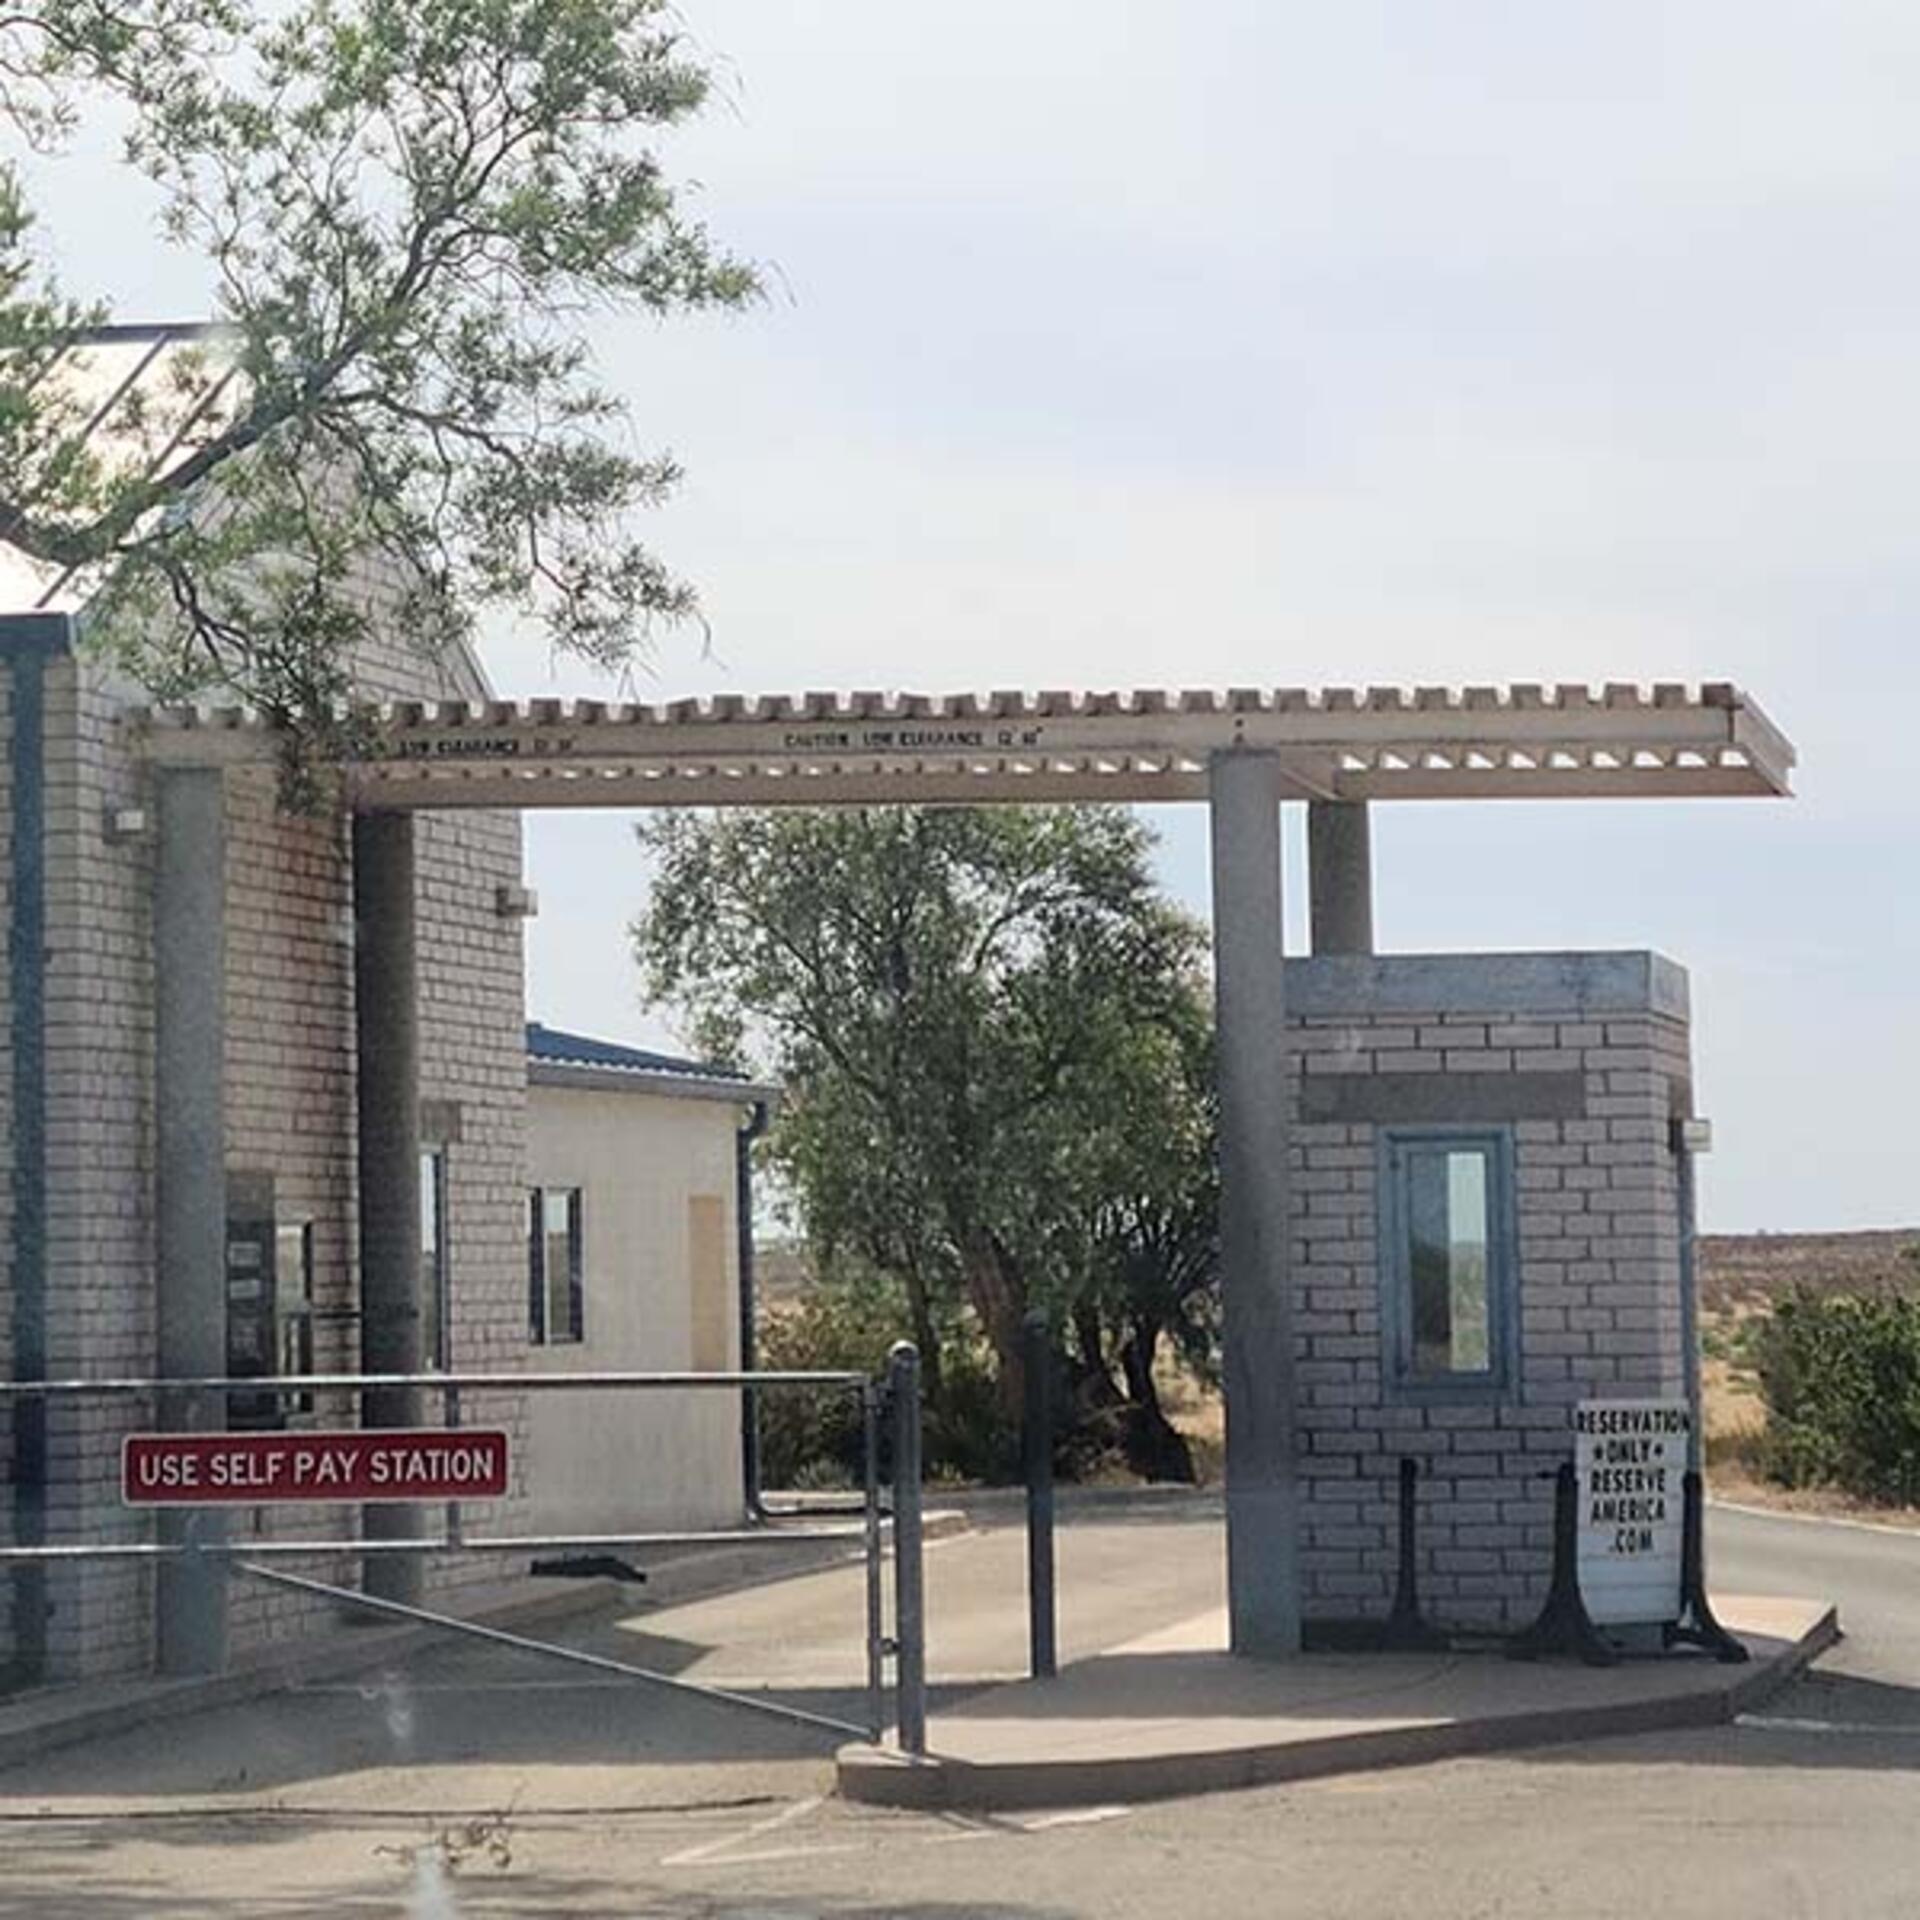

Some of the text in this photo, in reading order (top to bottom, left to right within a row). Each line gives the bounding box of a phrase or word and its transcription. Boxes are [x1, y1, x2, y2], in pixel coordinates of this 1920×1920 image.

[784, 733, 849, 748] CAUTION
[863, 732, 893, 747] LOW
[900, 731, 983, 747] CLEARANCE
[1577, 1409, 1690, 1434] RESERVATION
[139, 1448, 494, 1486] USE SELF PAY STATION
[1591, 1468, 1666, 1493] RESERVE
[1591, 1499, 1665, 1523] AMERICA
[1609, 1528, 1653, 1553] .COM
